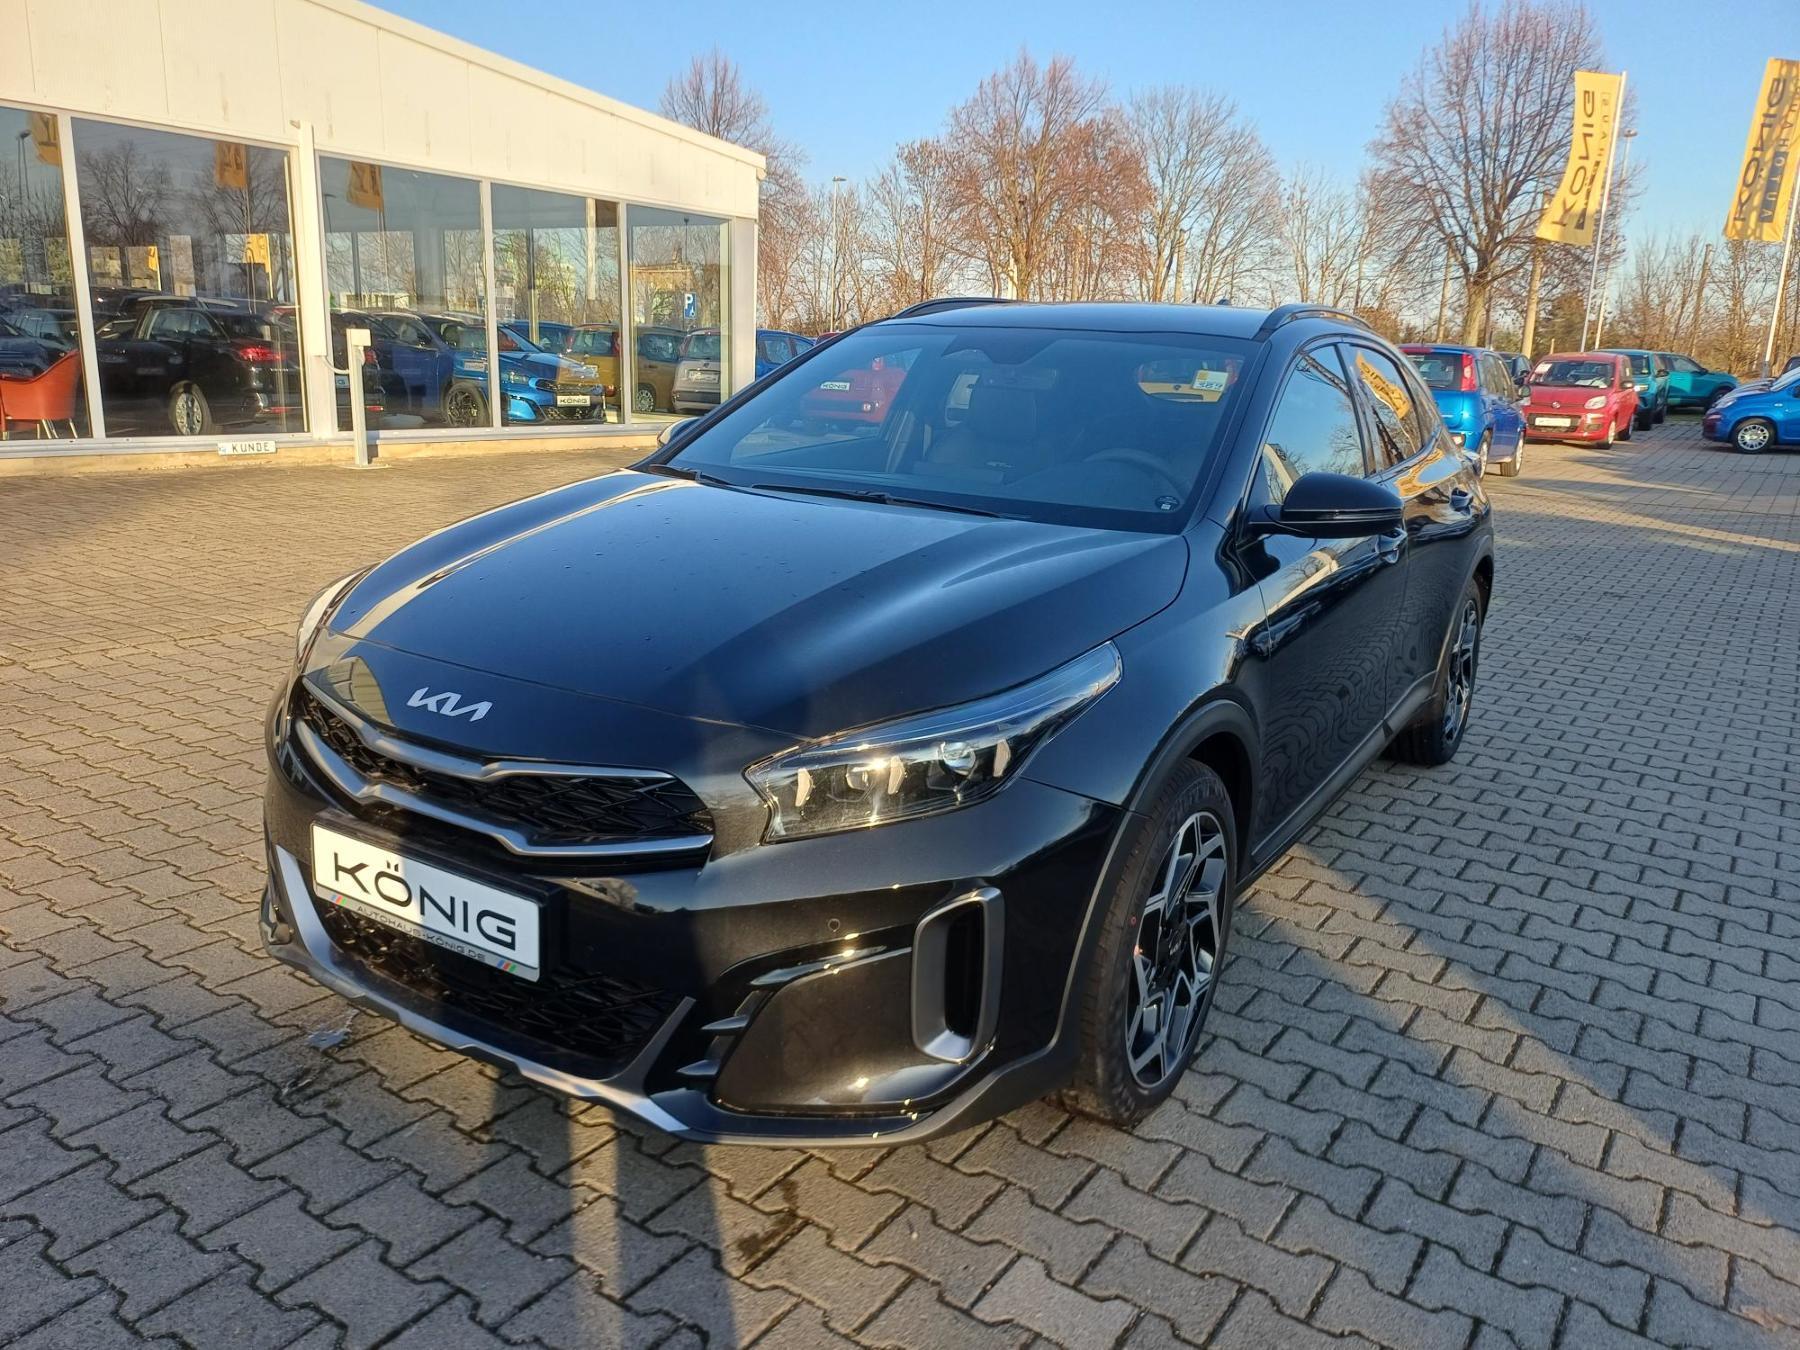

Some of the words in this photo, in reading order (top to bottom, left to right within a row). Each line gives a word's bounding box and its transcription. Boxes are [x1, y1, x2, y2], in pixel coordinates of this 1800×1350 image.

[685, 293, 694, 309] P
[231, 442, 270, 453] KUNDE
[333, 852, 517, 951] KÖNIG
